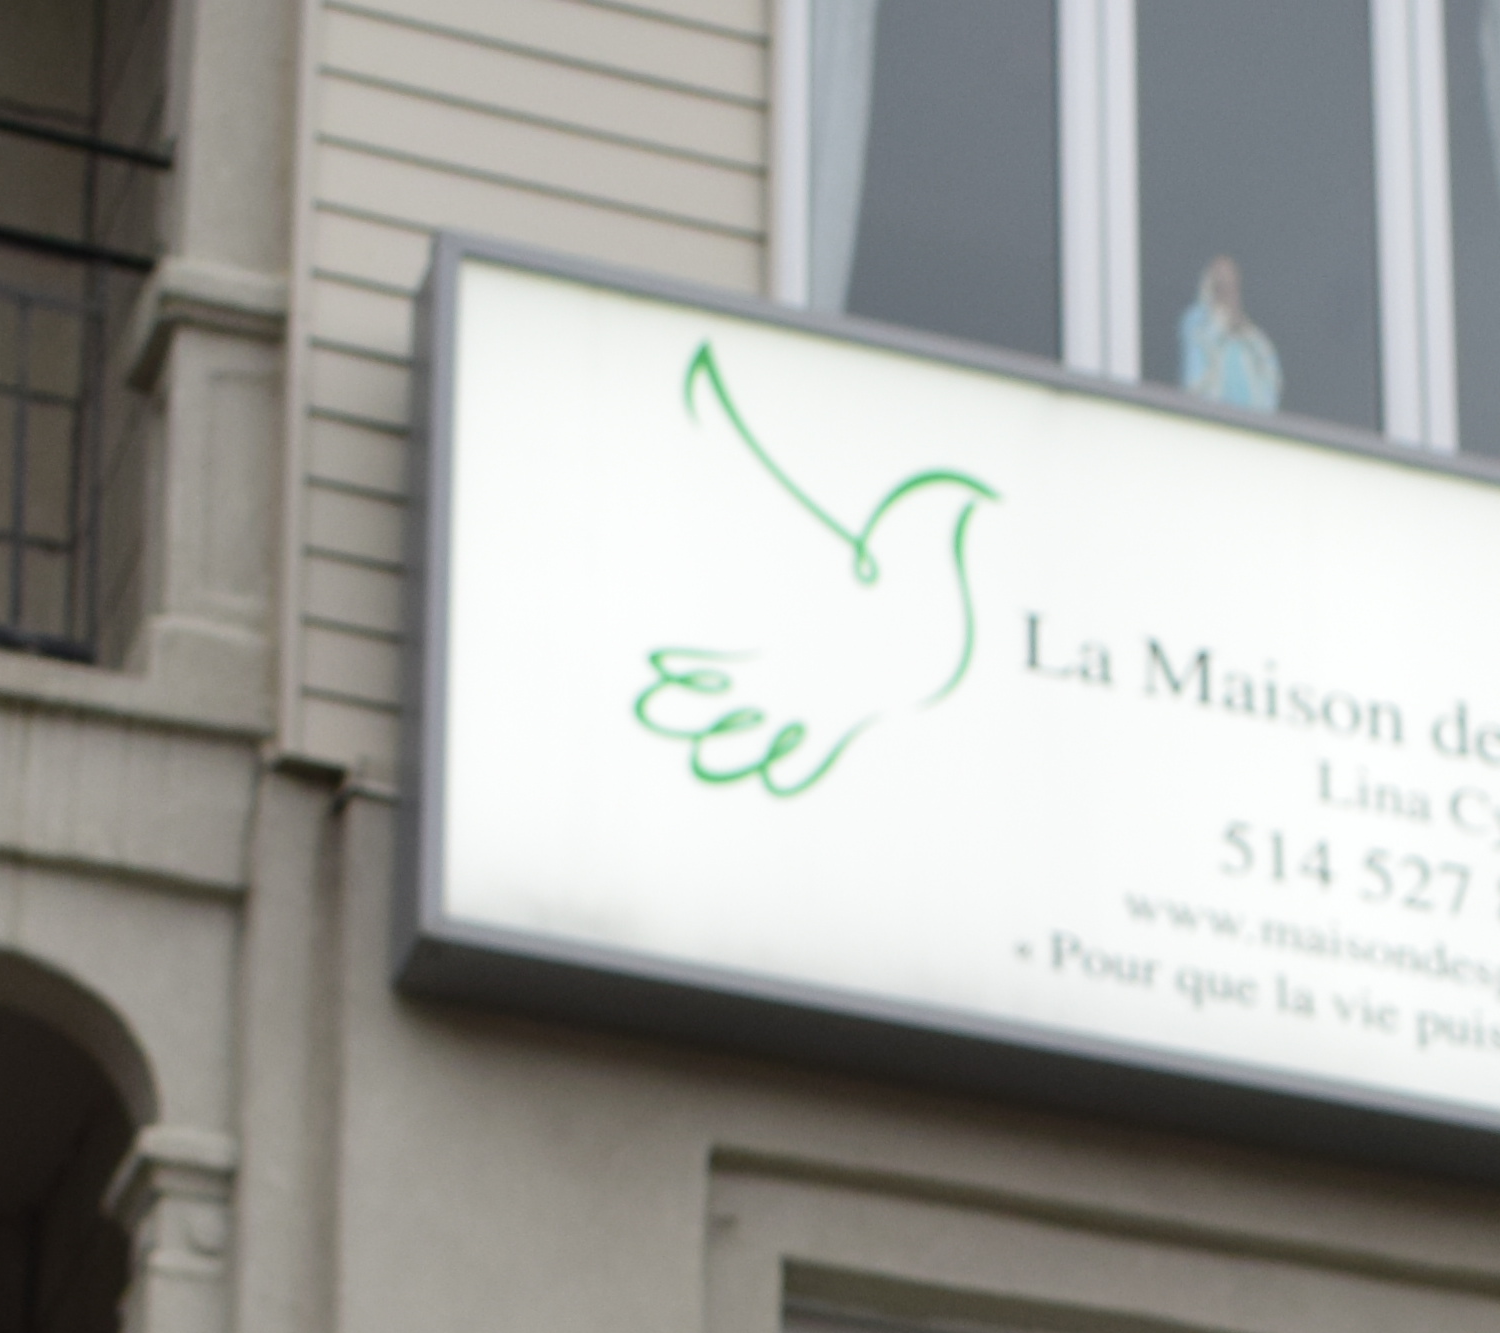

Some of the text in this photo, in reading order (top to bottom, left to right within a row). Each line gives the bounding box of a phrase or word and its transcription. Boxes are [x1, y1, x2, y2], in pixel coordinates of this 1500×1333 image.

[1021, 610, 1114, 690] La
[1140, 634, 1408, 750] Maison
[1316, 760, 1434, 832] Lina
[1218, 820, 1334, 892] 514
[1360, 848, 1474, 916] 527
[1048, 932, 1160, 992] Pour
[1174, 964, 1260, 1014] que
[1274, 974, 1318, 1018] la
[1330, 986, 1402, 1034] vie
